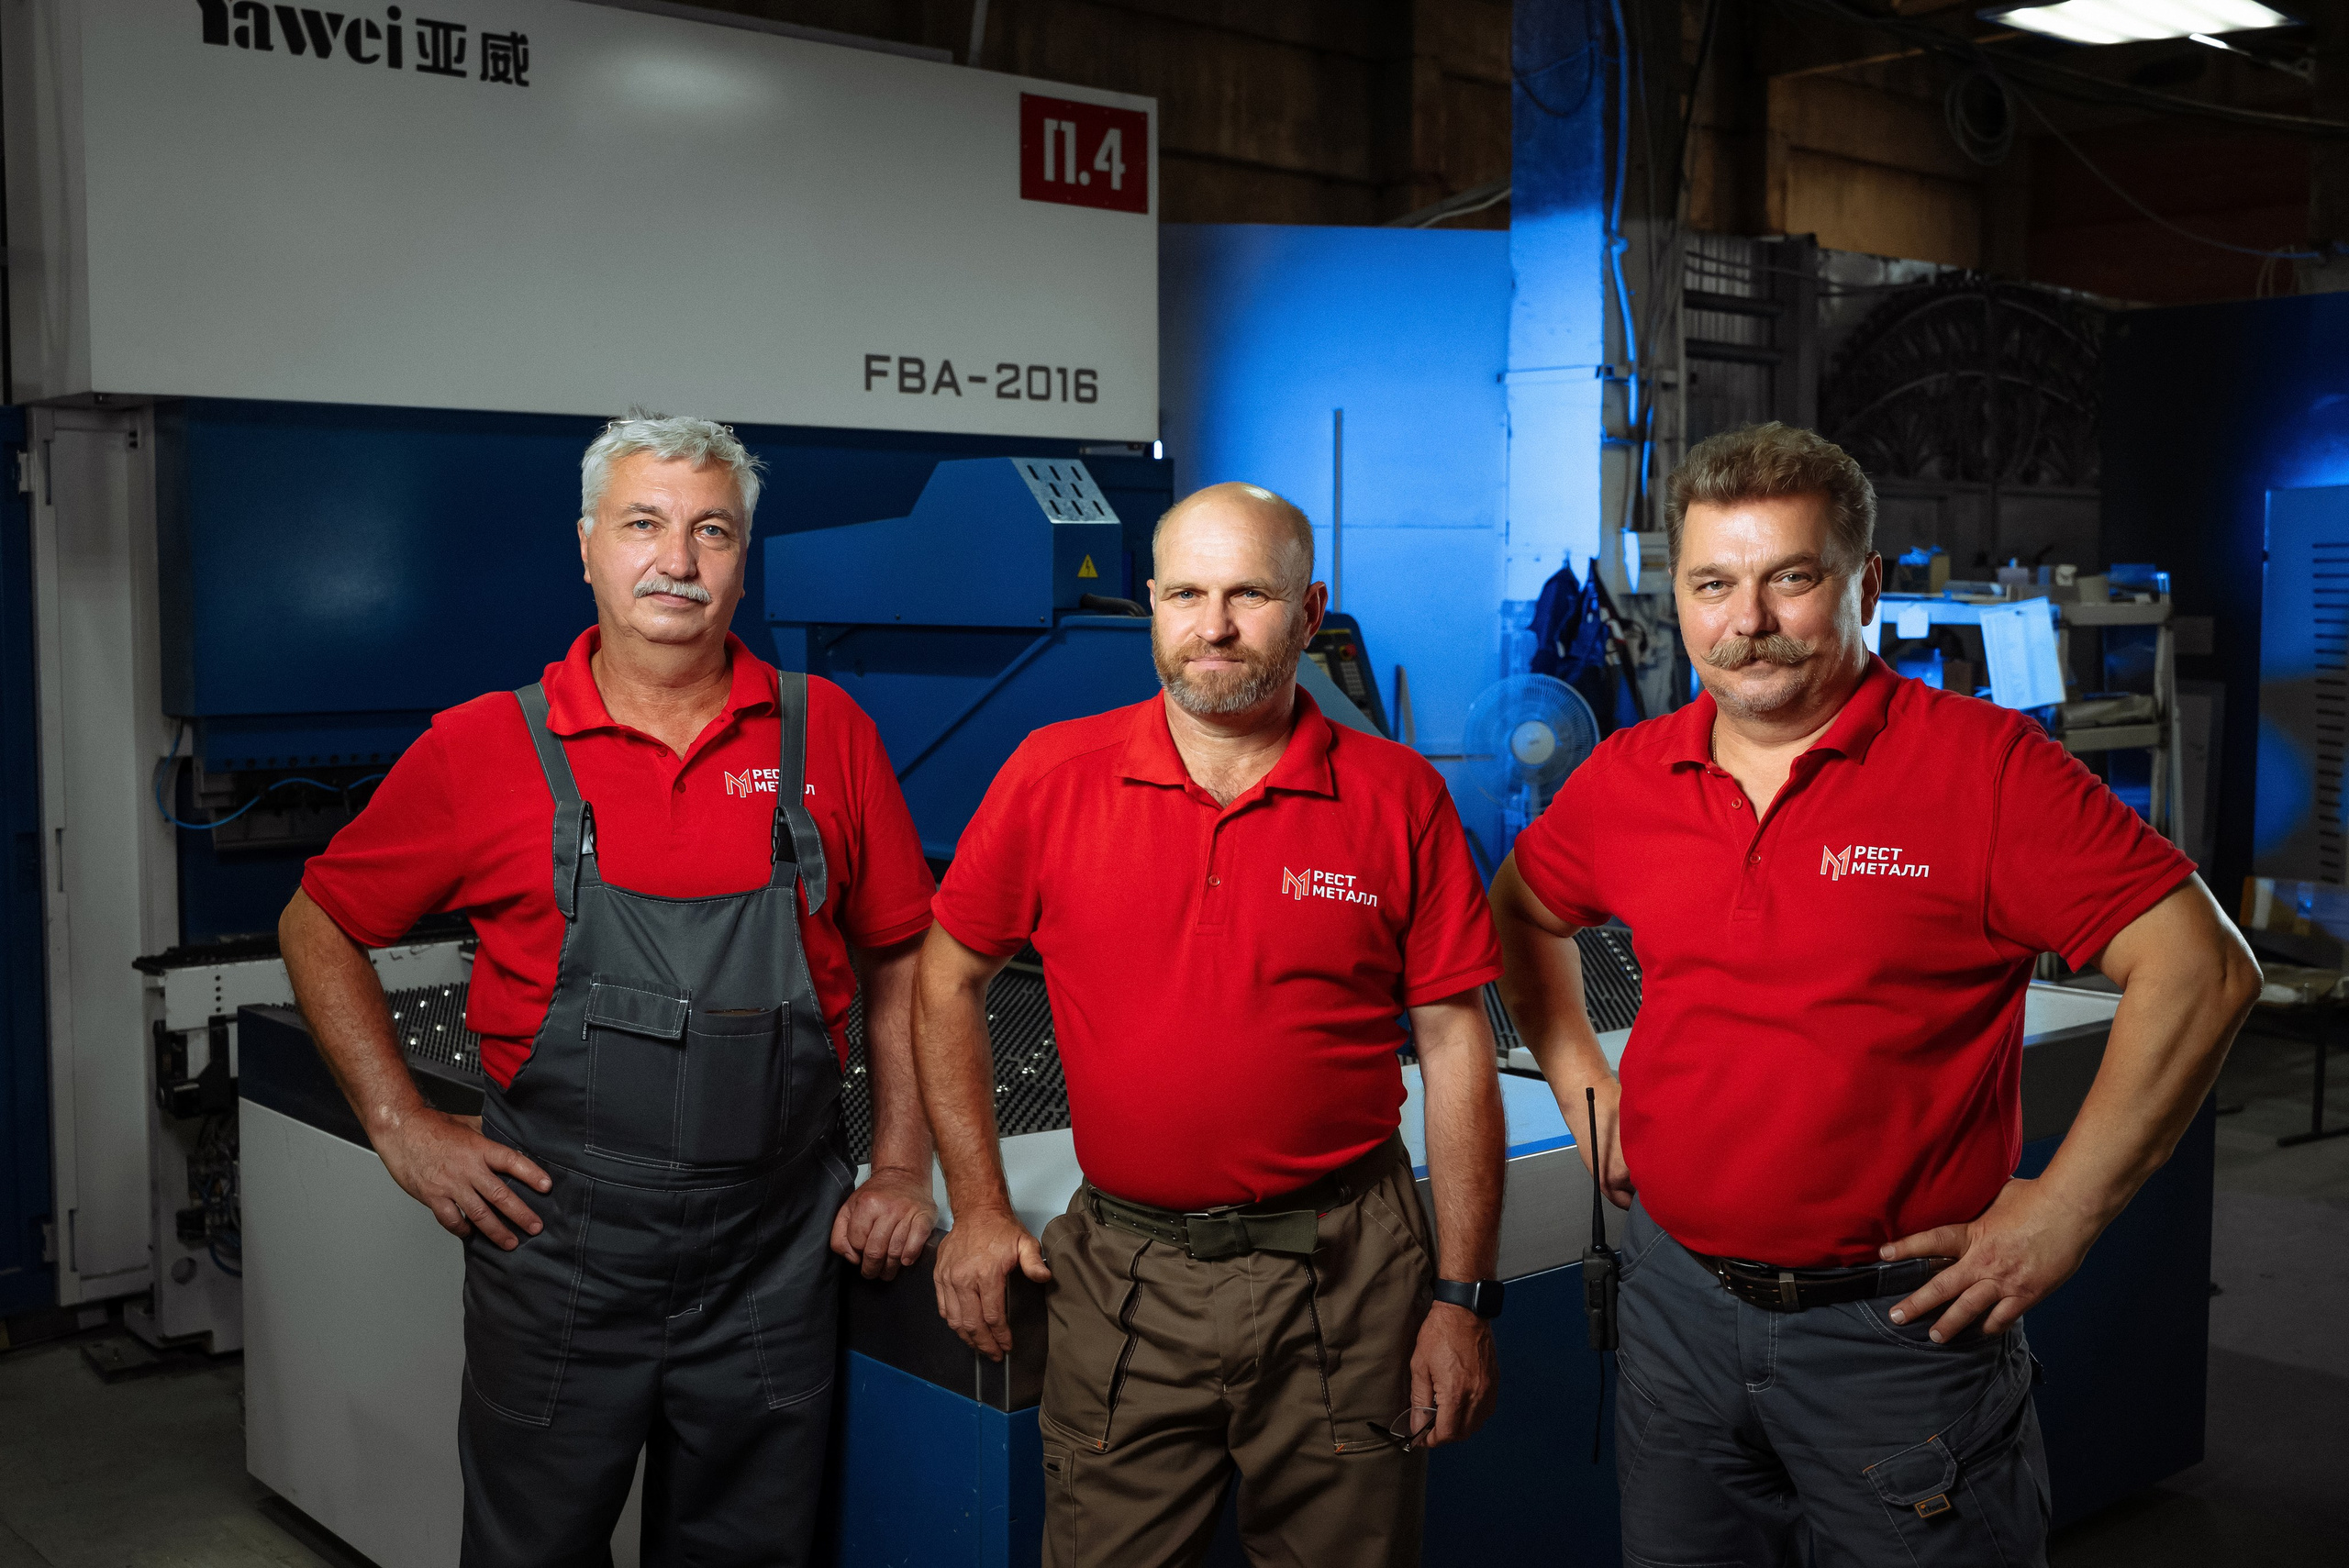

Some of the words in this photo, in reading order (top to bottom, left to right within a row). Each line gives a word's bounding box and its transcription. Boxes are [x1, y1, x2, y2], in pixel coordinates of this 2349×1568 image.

[195, 0, 404, 70] Yawei
[415, 17, 530, 88] 亚威
[1042, 117, 1127, 191] П.4
[864, 353, 1098, 404] FBA-2016
[752, 769, 781, 780] РЕС
[1854, 845, 1903, 861] РЕСТ
[1313, 870, 1357, 887] РЕСТ
[1851, 862, 1930, 878] МЕТАЛЛ
[1312, 884, 1378, 907] МЕТАЛЛ
